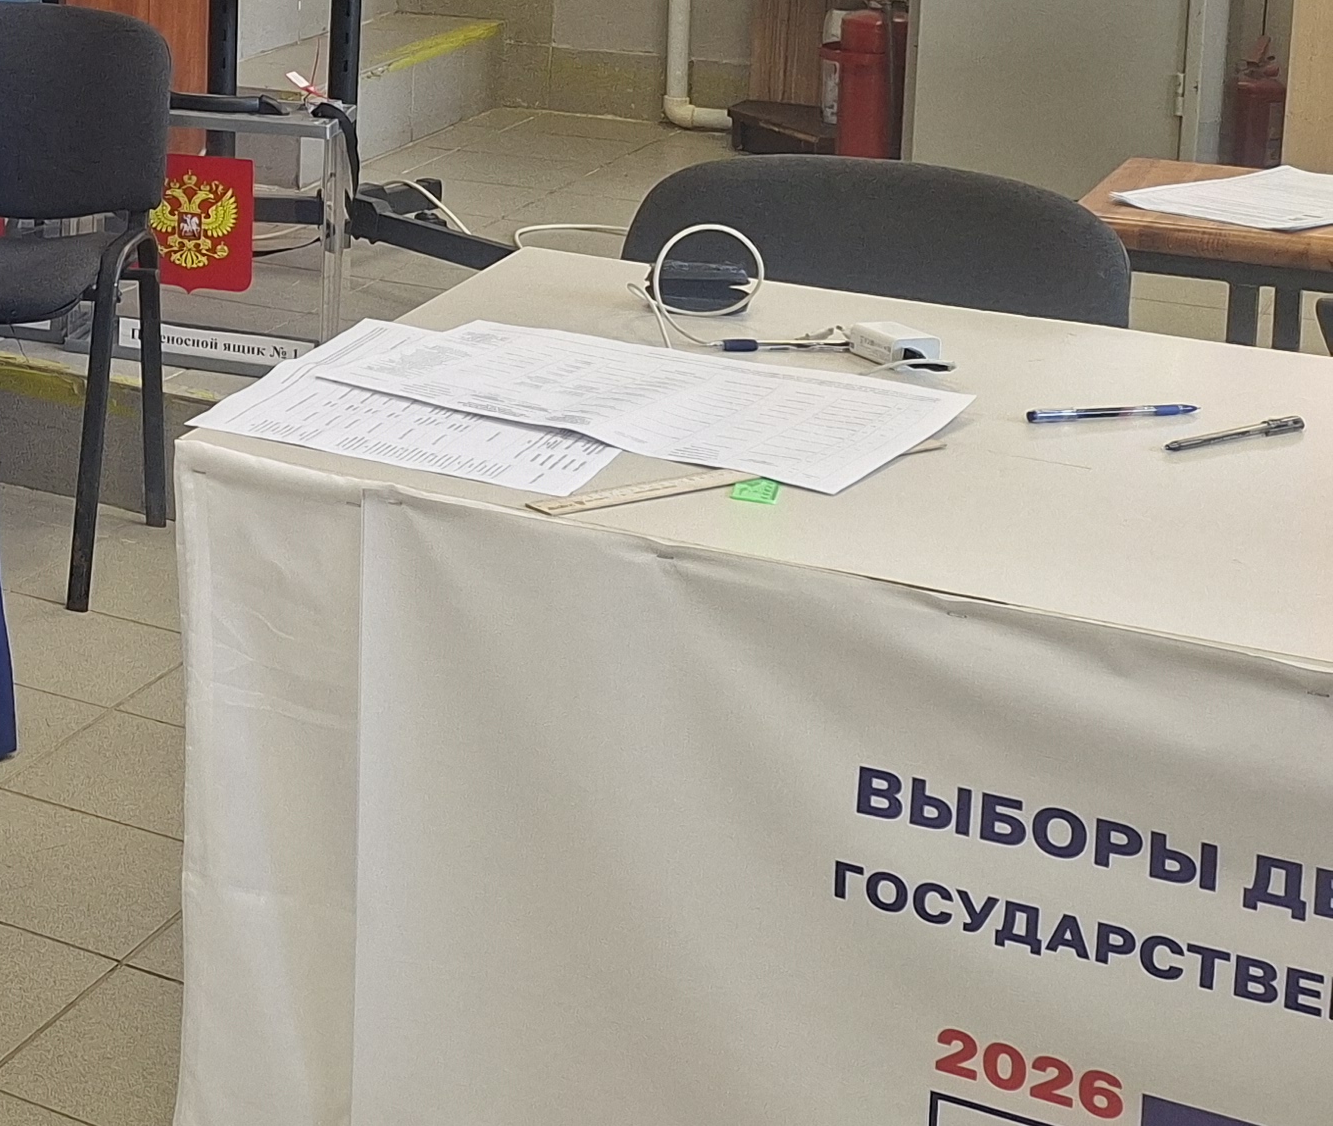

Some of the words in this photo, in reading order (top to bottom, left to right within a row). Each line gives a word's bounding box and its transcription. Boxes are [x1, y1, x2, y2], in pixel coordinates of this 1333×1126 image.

[131, 327, 218, 350] Пеносной
[223, 342, 266, 357] ящик
[269, 345, 287, 359] №
[292, 348, 299, 359] 1
[856, 765, 1219, 892] ВЫБОРЫ
[834, 860, 1333, 1022] ГОСУДАРСТВЕ
[935, 1028, 1124, 1120] 2026
